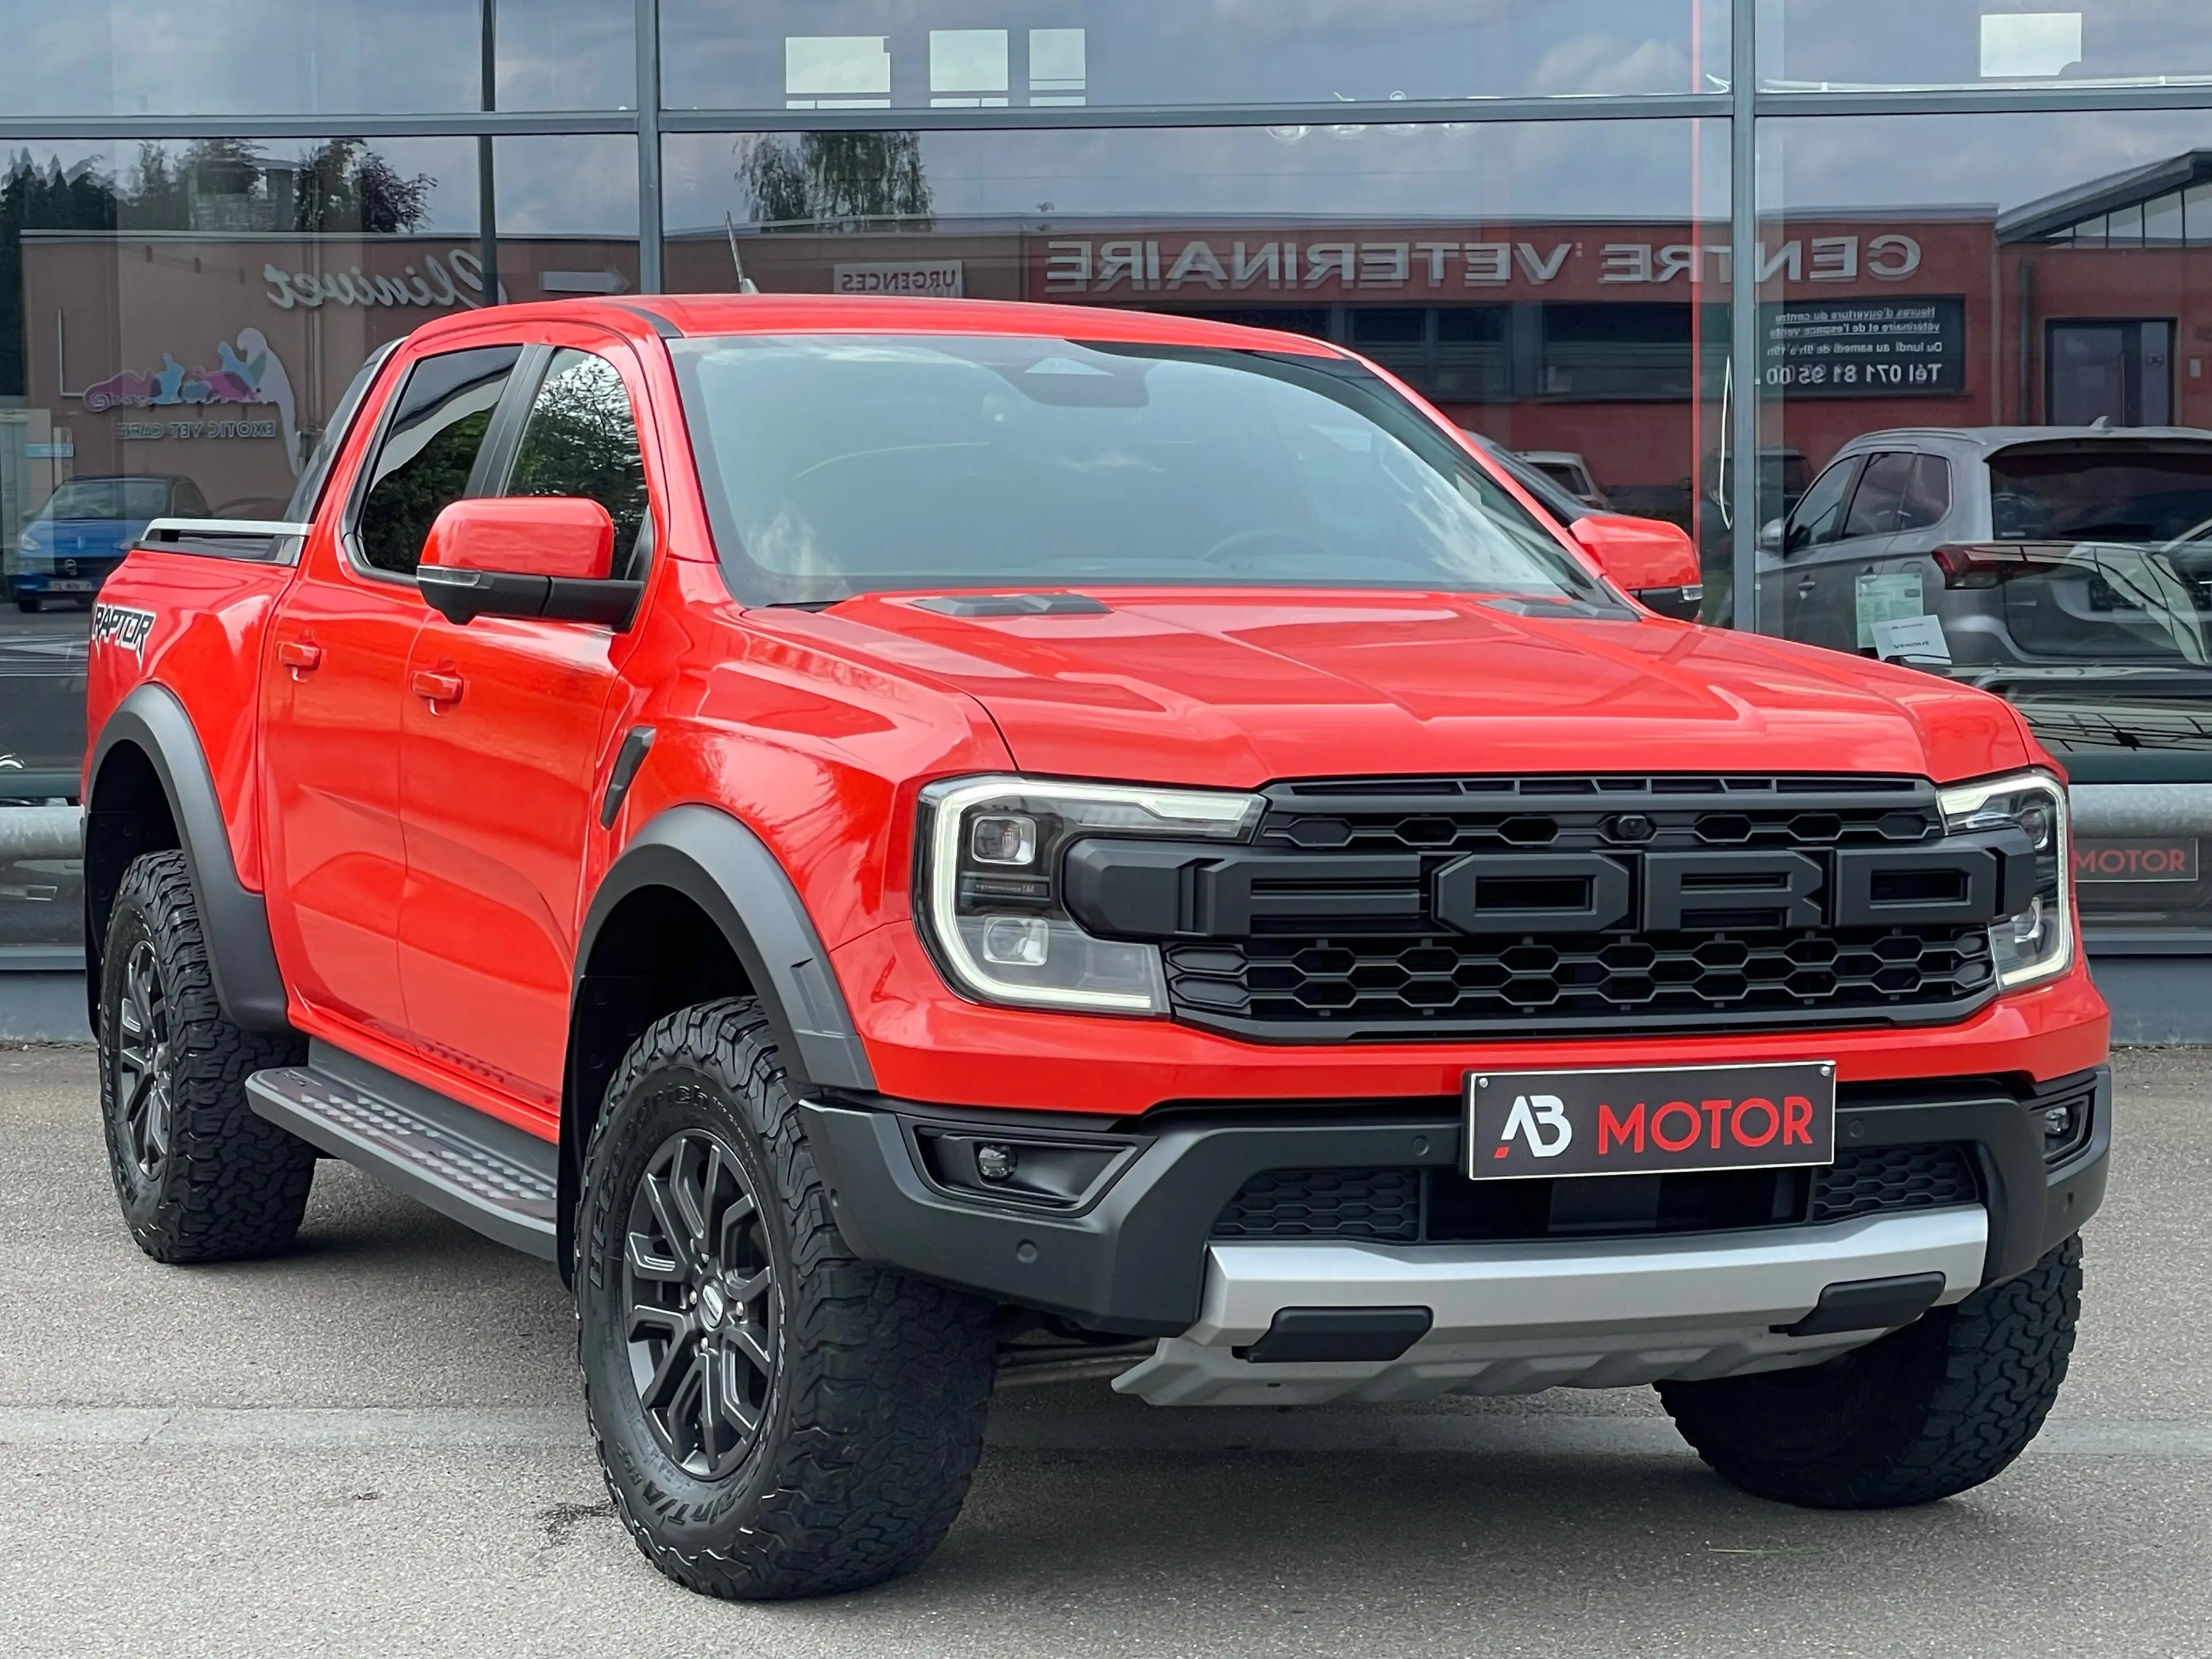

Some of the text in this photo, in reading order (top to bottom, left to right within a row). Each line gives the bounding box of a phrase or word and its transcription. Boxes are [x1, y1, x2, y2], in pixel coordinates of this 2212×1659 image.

[92, 604, 156, 666] RAPTOR
[2073, 849, 2186, 873] MOTOR
[1204, 850, 1997, 935] FORD
[1495, 1095, 1813, 1158] AB MOTOR
